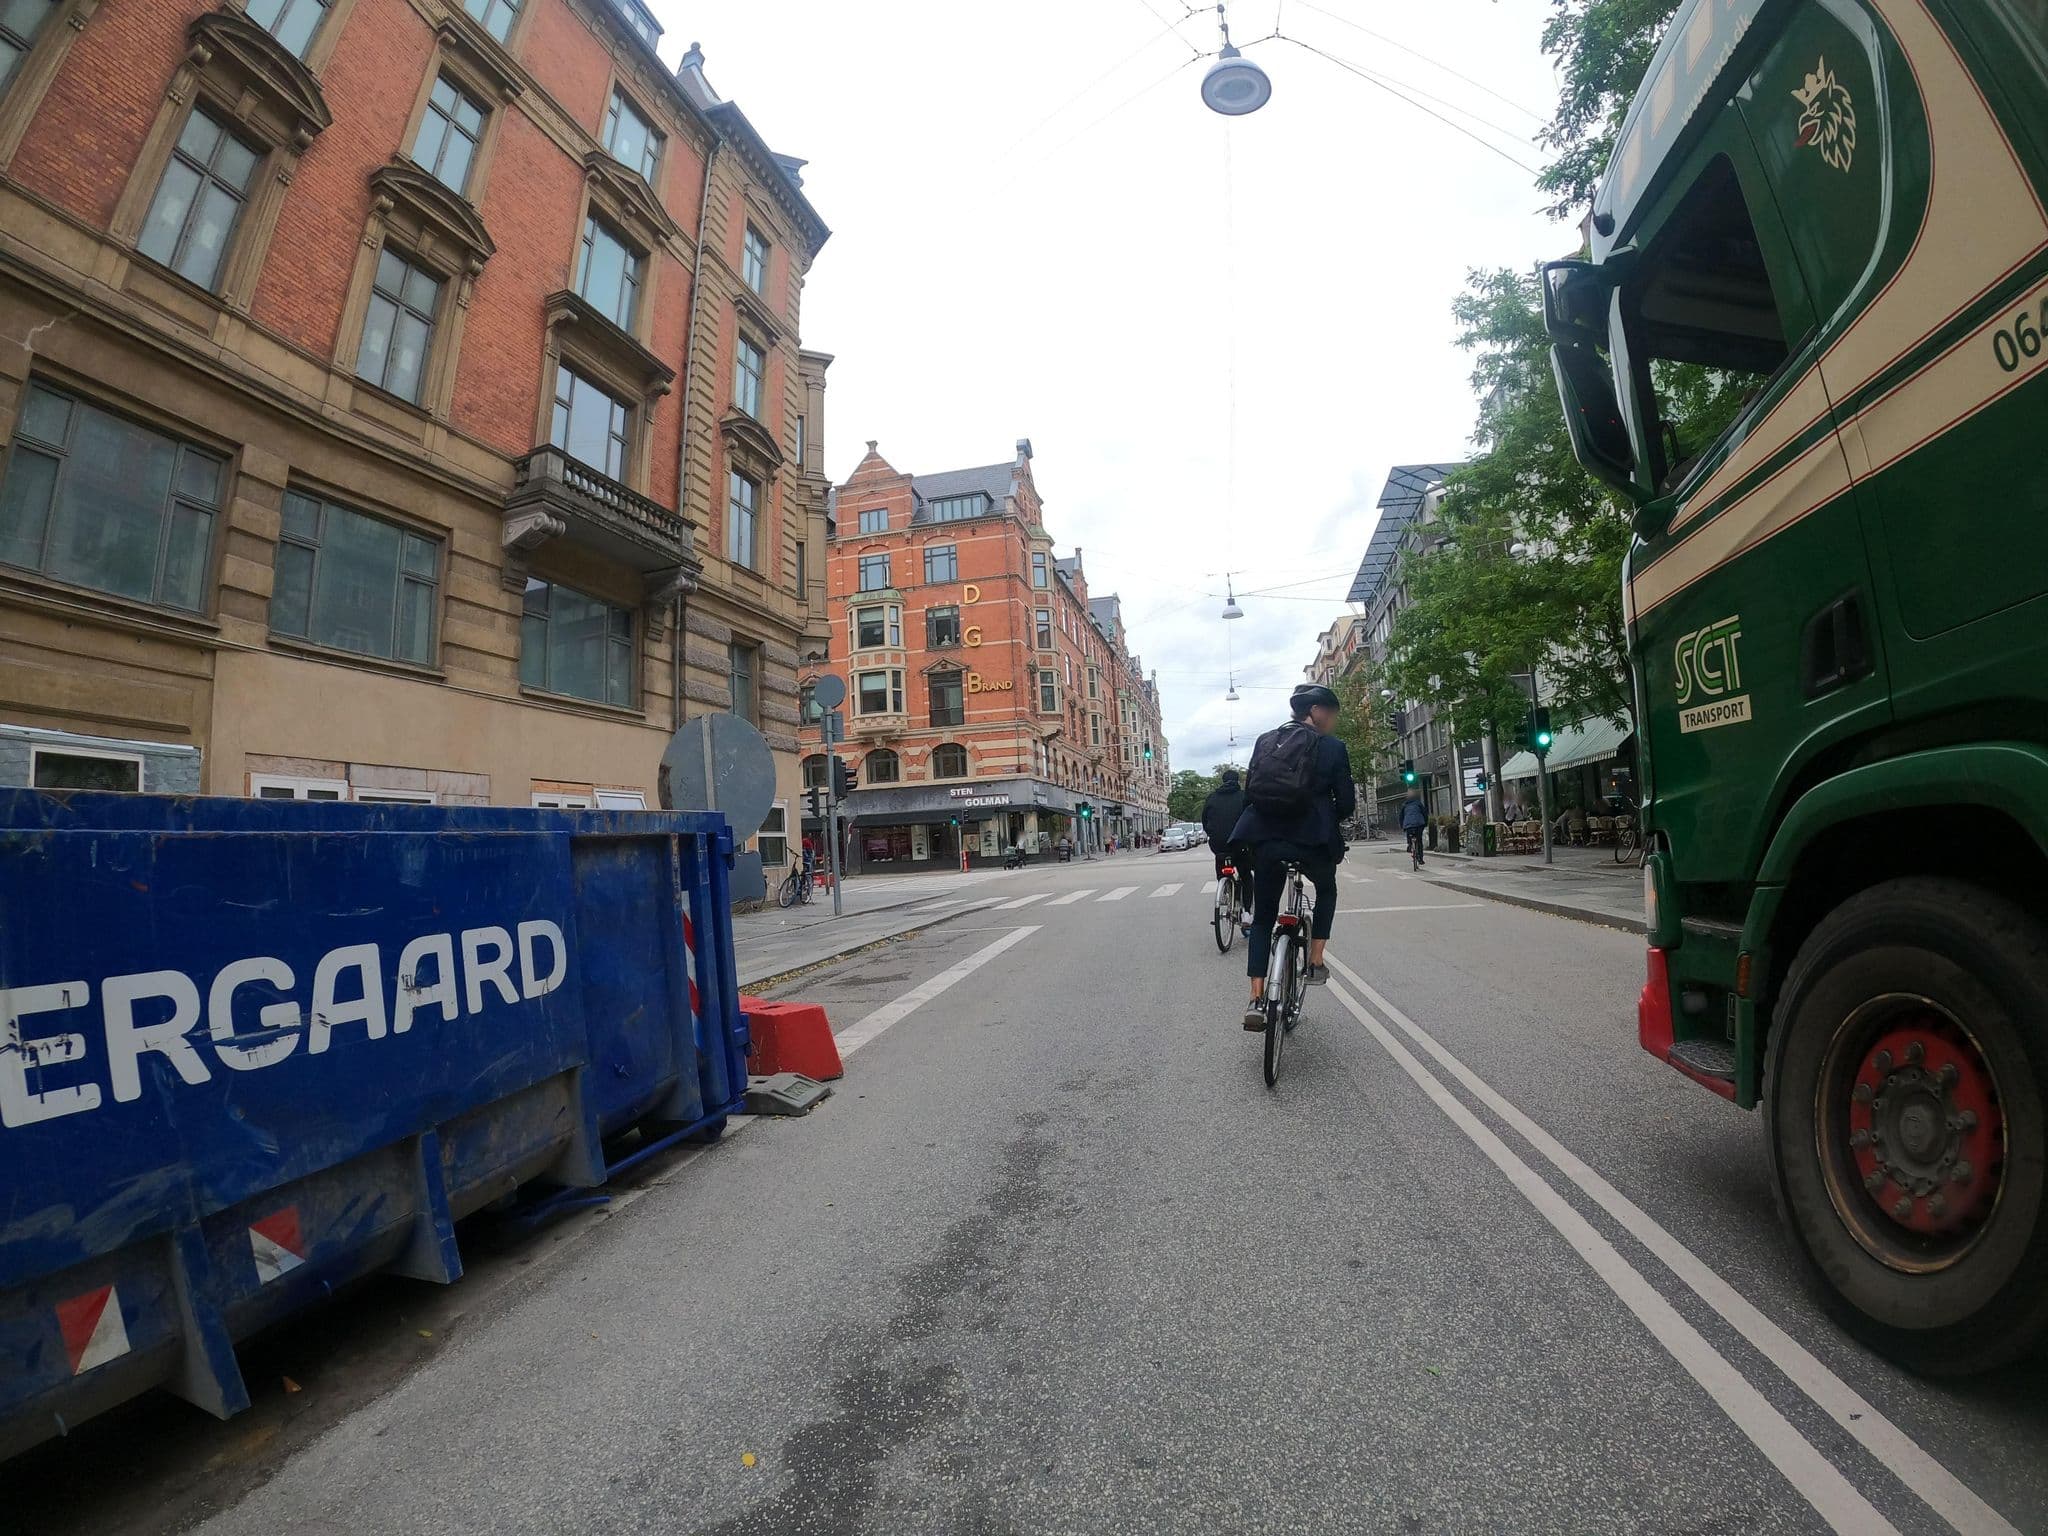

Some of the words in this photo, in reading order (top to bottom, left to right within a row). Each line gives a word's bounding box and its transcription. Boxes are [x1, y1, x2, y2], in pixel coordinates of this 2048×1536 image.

[1681, 14, 1753, 129] www.sct.dk
[963, 584, 980, 604] D
[963, 625, 981, 647] G
[1675, 614, 1742, 704] SCT
[1684, 701, 1744, 728] TRANSPORT
[950, 787, 973, 796] STEN
[965, 796, 1009, 807] GOLMAN
[0, 919, 566, 1128] ERGAARD
